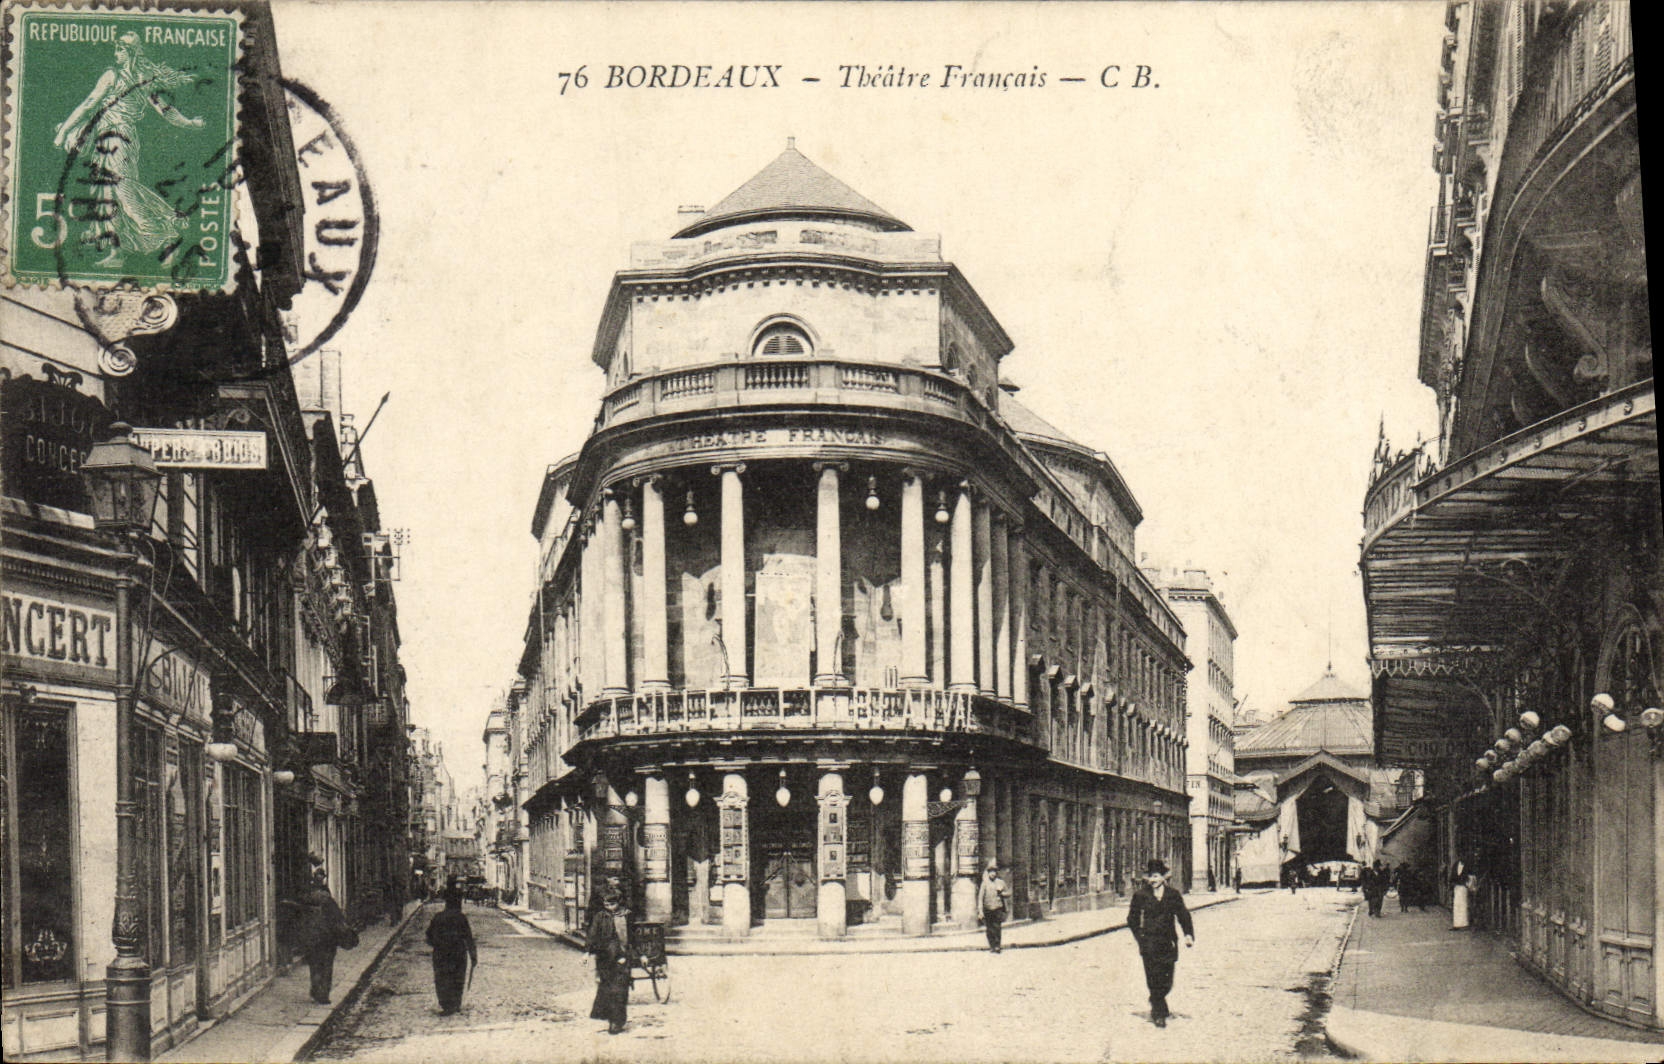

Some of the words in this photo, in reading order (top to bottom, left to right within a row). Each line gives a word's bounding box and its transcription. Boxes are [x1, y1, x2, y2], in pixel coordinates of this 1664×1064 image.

[29, 22, 118, 45] REPUBLIQUE
[144, 25, 227, 49] FRANÇAISE
[30, 192, 68, 249] 5
[198, 181, 221, 267] POSTES
